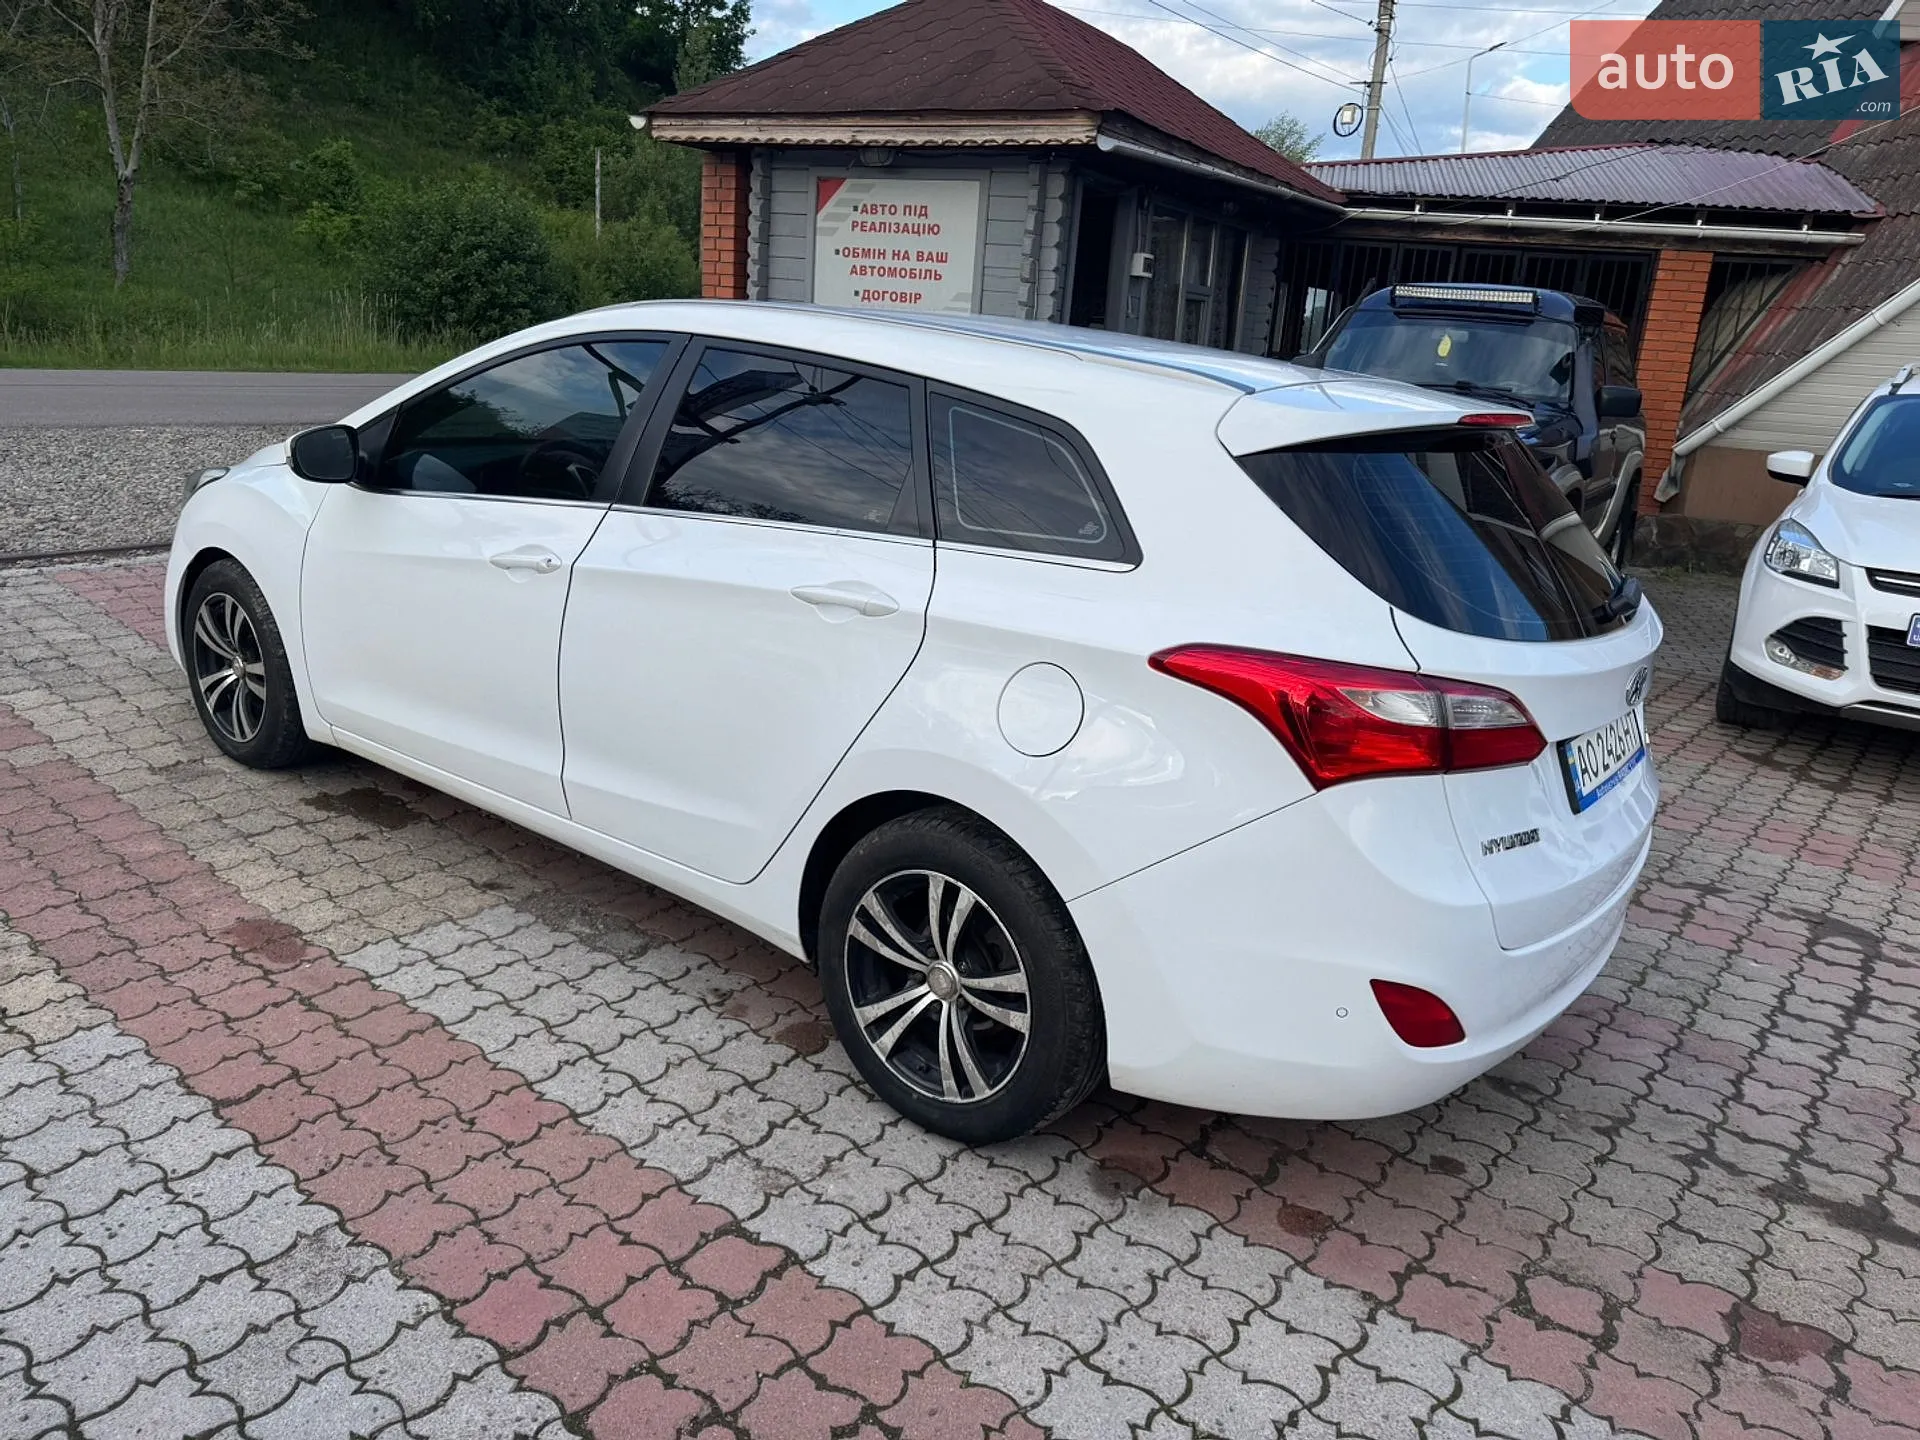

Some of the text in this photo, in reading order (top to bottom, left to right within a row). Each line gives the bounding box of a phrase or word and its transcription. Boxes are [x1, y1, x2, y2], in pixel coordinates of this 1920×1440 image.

[860, 203, 929, 219] АВТО ПІД
[851, 221, 941, 237] РЕАЛІЗАЦІЮ
[841, 246, 949, 264] ОБМІН НА ВАШ
[849, 264, 943, 282] АВТОМОБІЛЬ
[860, 289, 923, 305] ДОГОВІР
